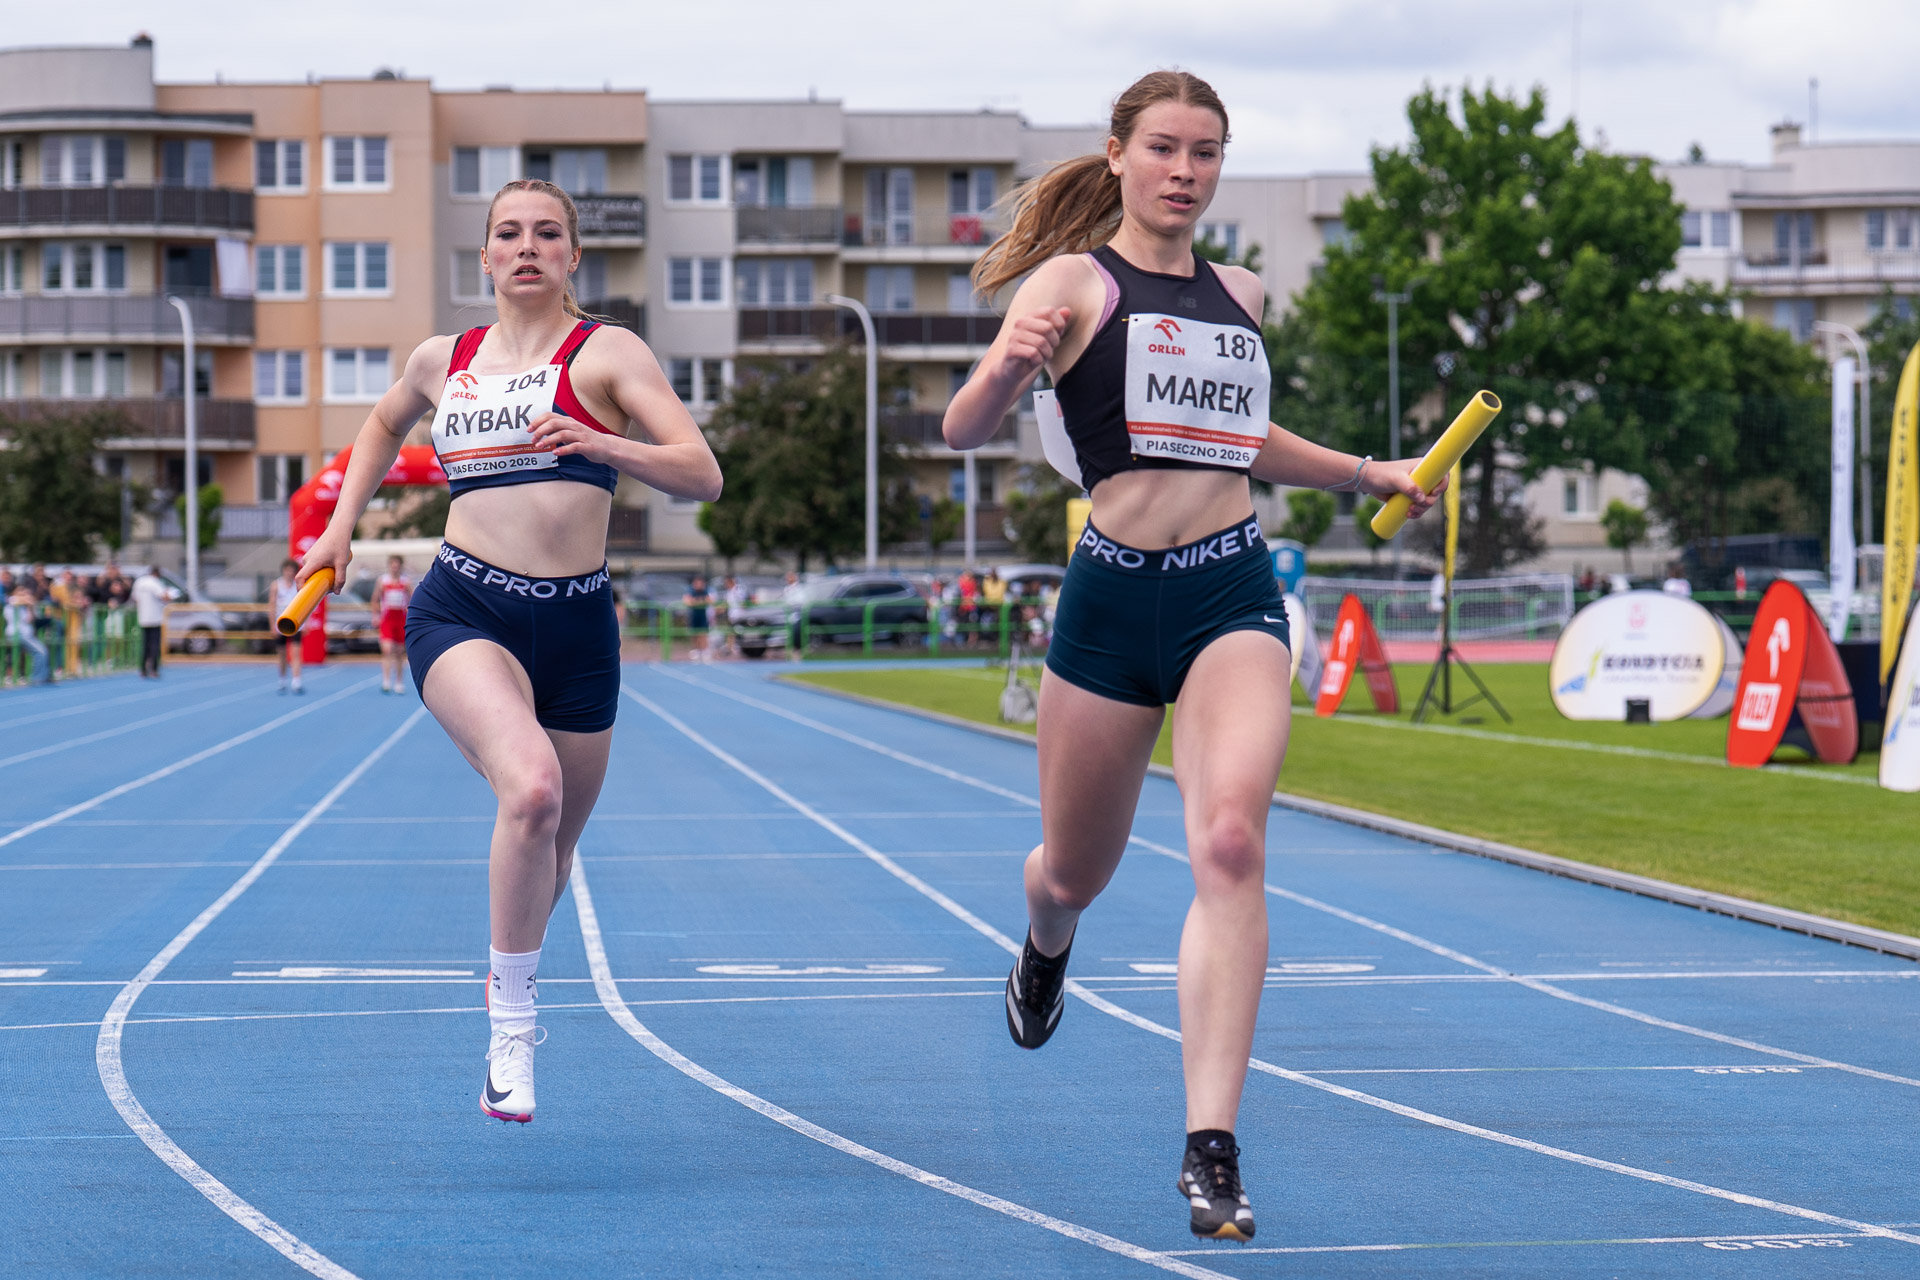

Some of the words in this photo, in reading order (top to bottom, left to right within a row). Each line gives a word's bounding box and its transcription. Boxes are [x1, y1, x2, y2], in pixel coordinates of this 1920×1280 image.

[1148, 343, 1186, 356] ORLEN
[1214, 333, 1257, 362] 187
[504, 370, 547, 394] 104
[1146, 373, 1254, 417] MAREK
[445, 404, 533, 438] RYBAK
[509, 457, 538, 468] 2026
[1146, 440, 1218, 459] PIASECZNO
[1220, 448, 1250, 462] 2026
[1080, 528, 1145, 569] PRO
[1161, 530, 1242, 571] NIKE
[482, 572, 557, 599] PRO
[566, 564, 609, 597] NIK
